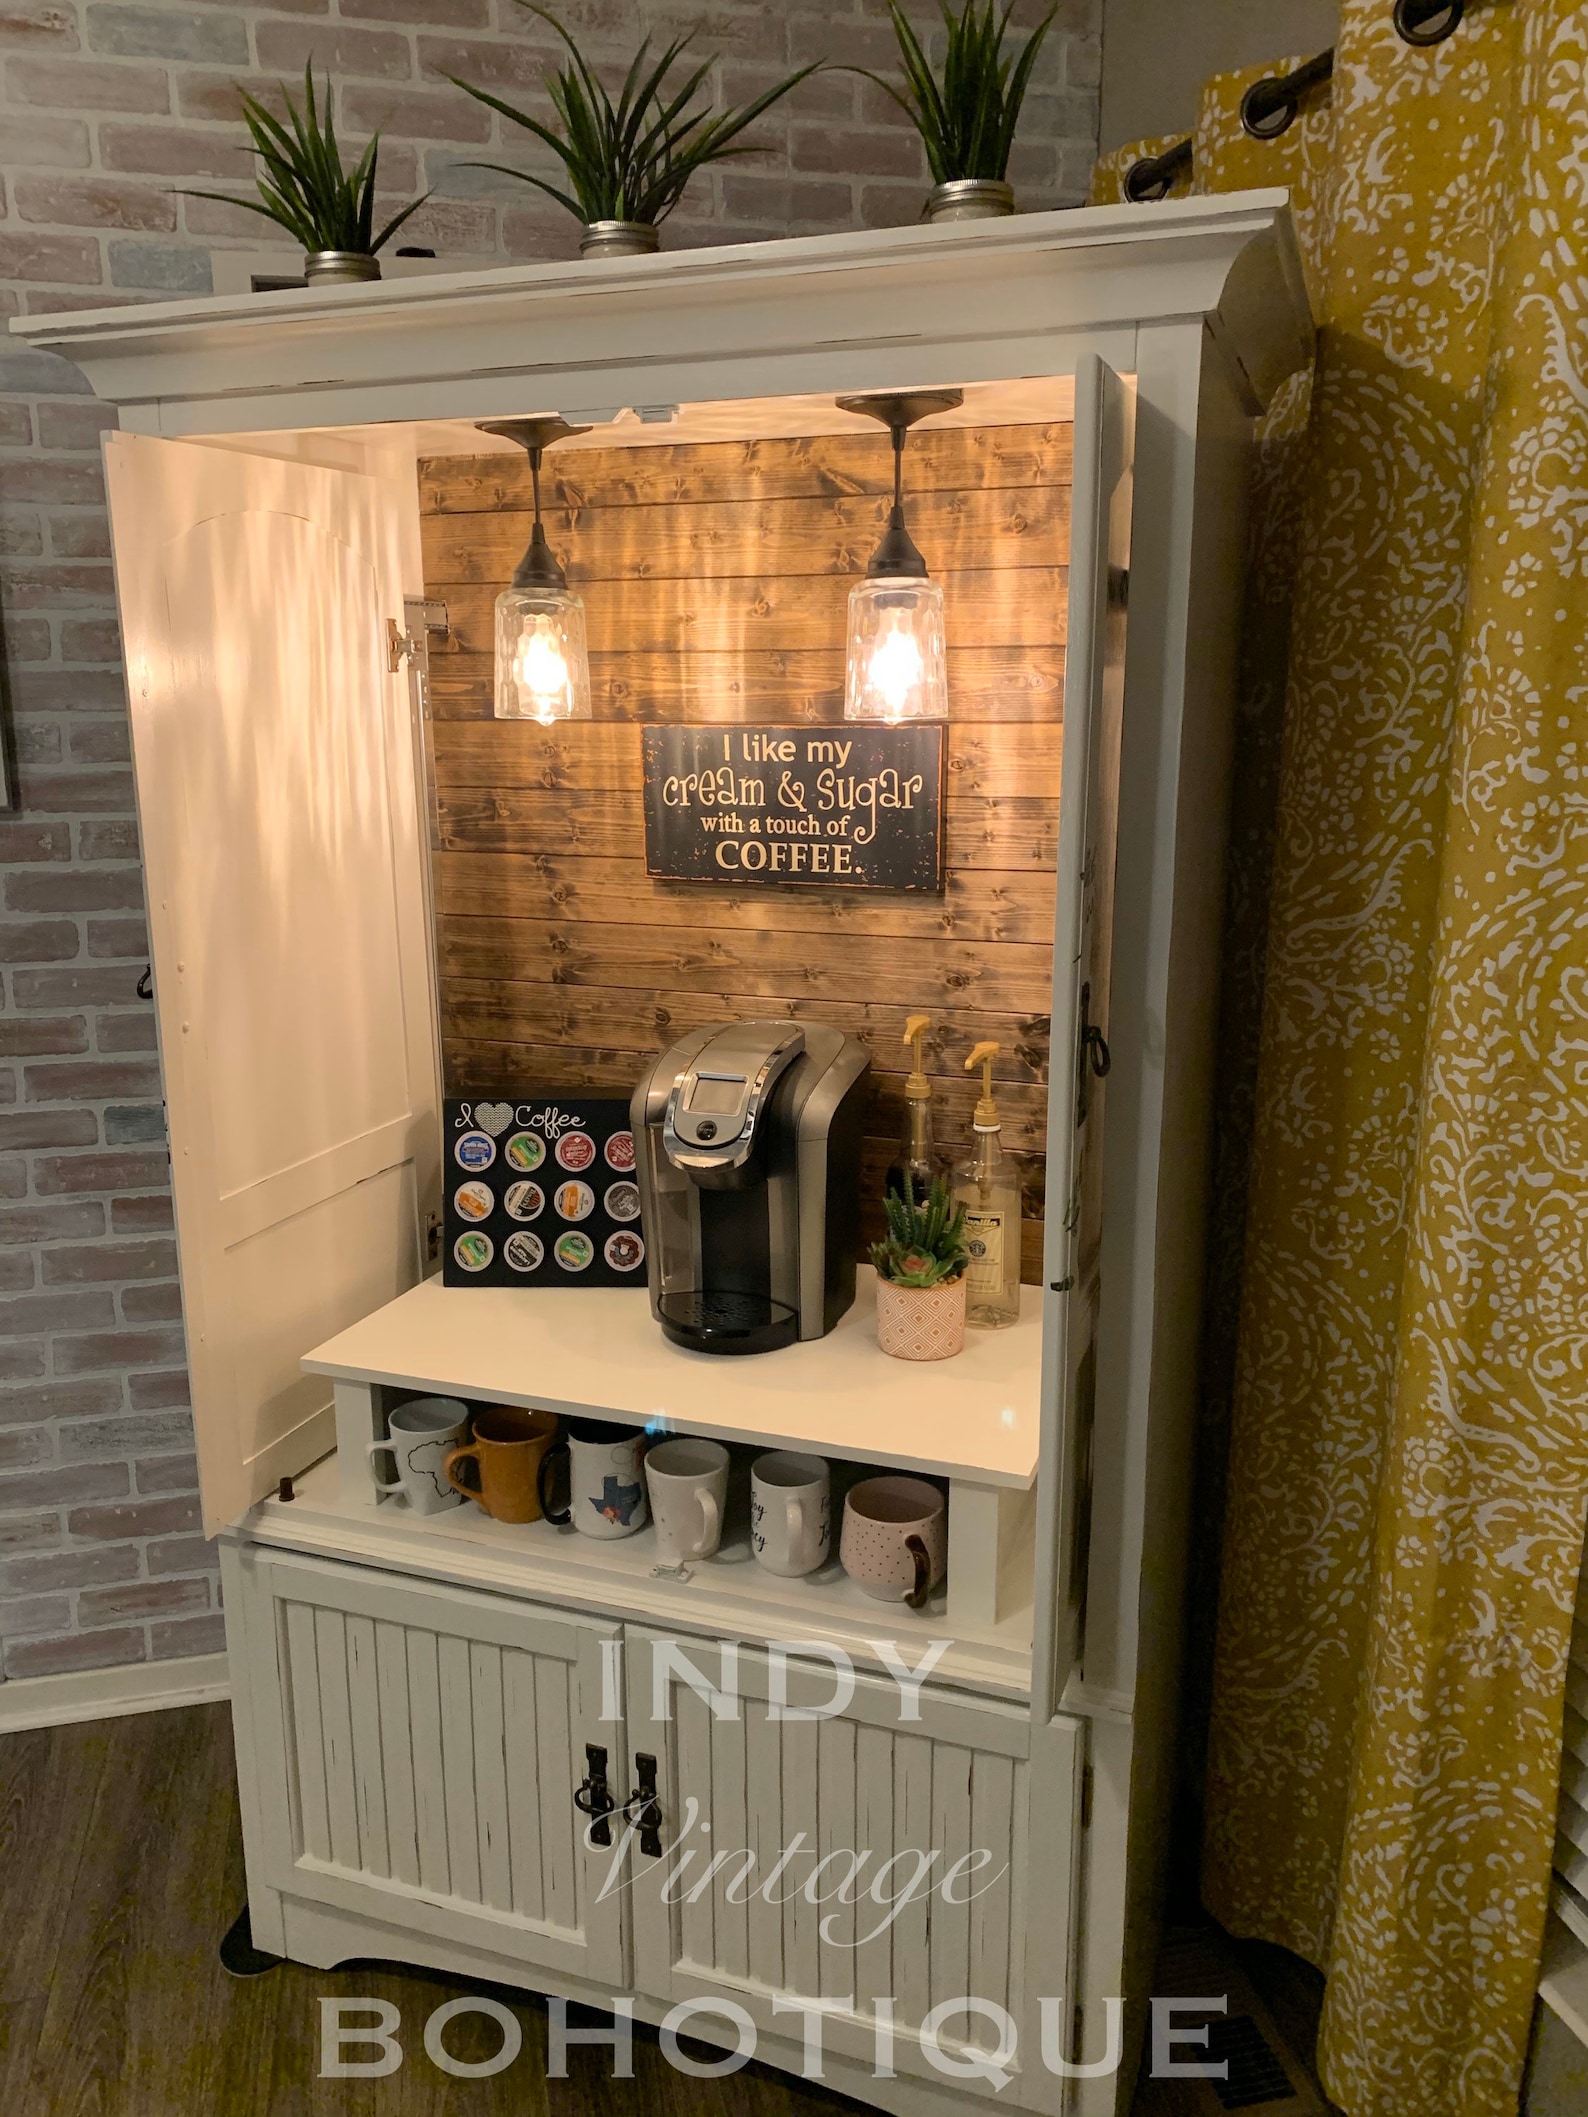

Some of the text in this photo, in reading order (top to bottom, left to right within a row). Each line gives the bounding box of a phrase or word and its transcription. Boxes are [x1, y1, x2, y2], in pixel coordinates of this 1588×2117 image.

[723, 733, 853, 769] I like my
[662, 766, 766, 807] cream
[777, 770, 807, 813] &
[700, 812, 850, 837] with a touch of
[715, 840, 863, 875] COFFEE.
[454, 1102, 587, 1140] I Coffee
